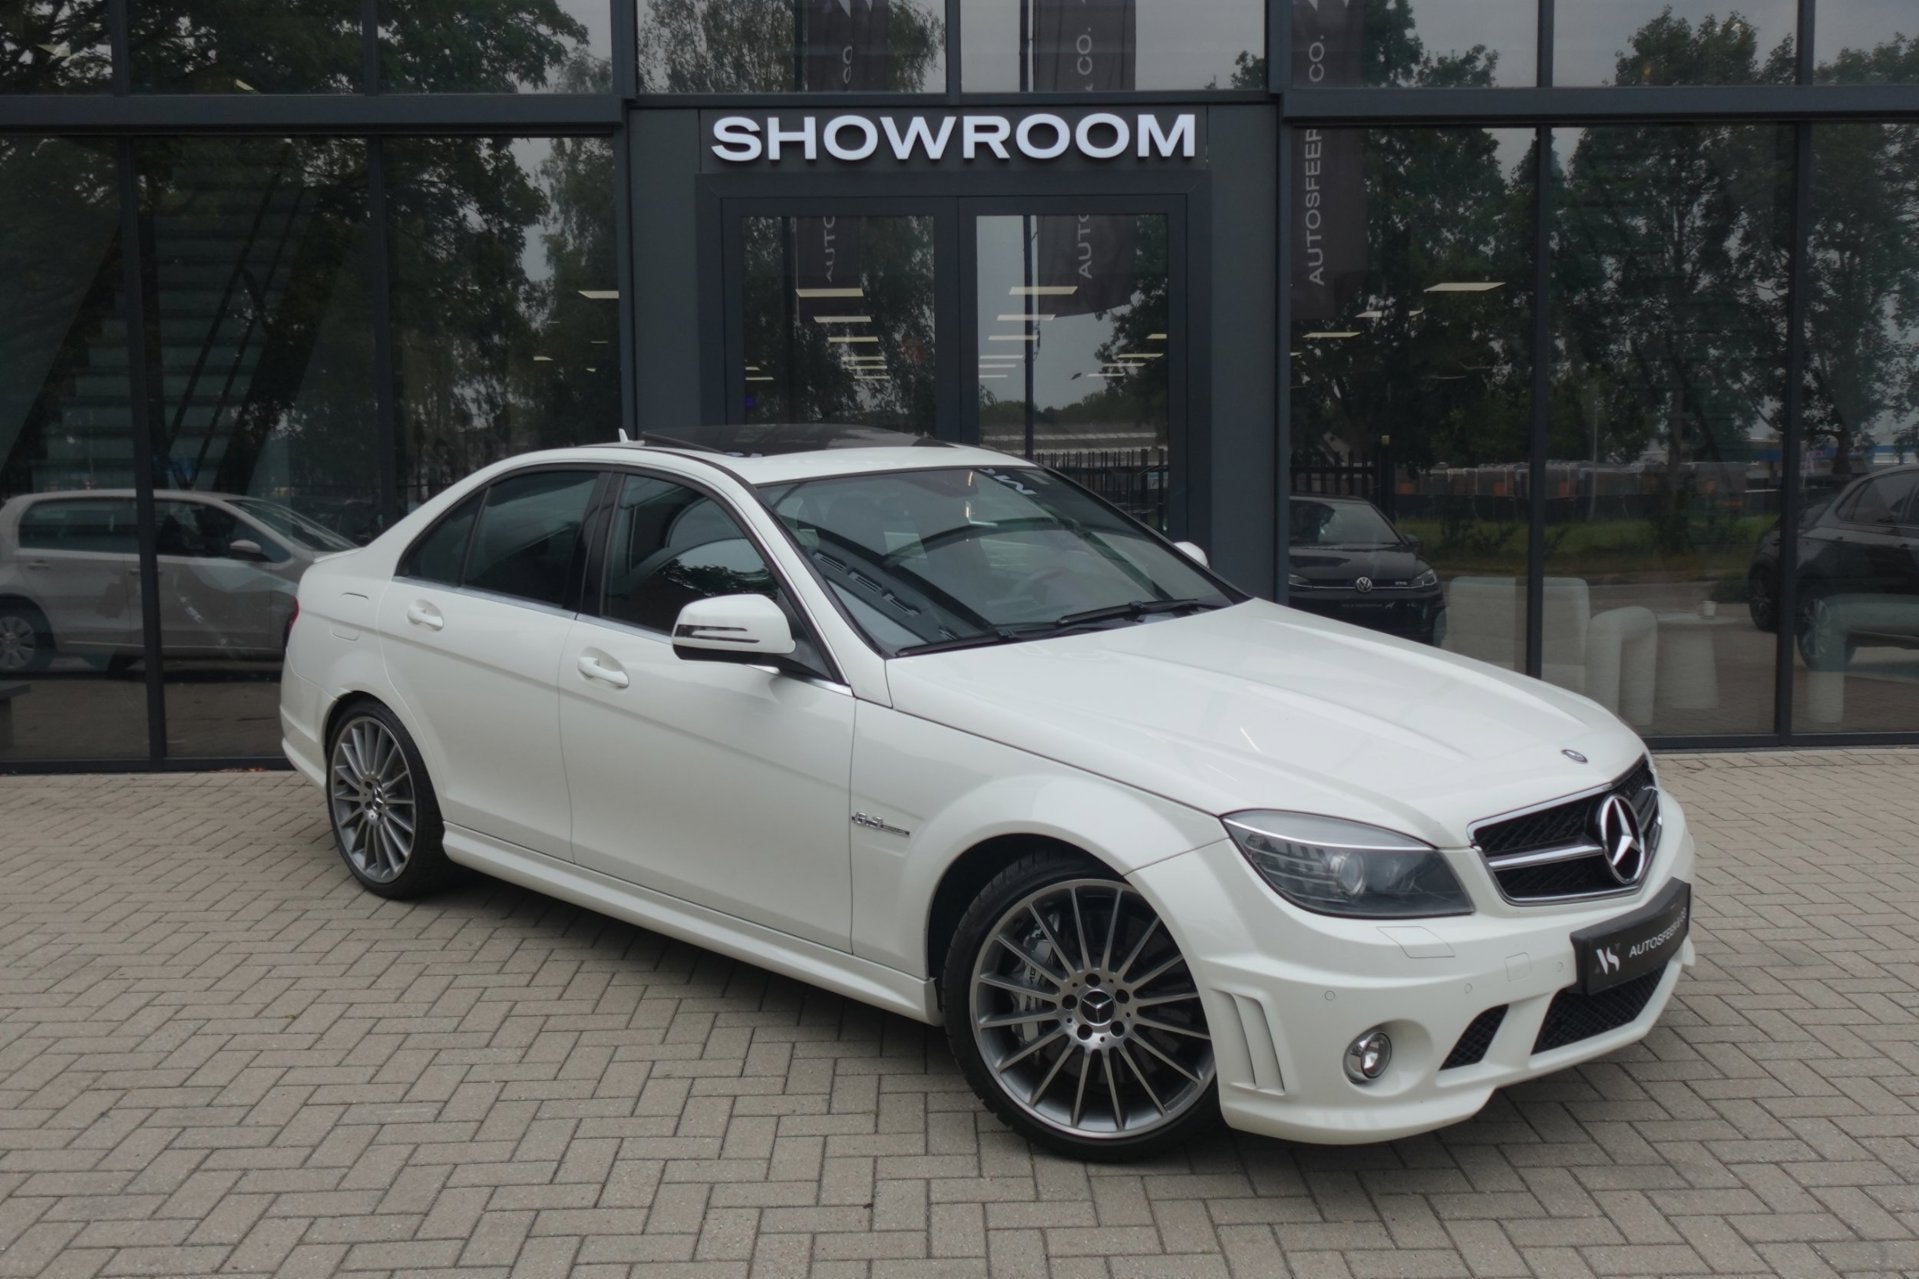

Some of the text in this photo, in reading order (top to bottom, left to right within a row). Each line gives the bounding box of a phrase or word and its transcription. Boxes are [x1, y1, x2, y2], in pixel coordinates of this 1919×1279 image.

[1076, 27, 1093, 76] CO.
[1308, 34, 1325, 82] CO.
[711, 112, 1197, 162] SHOWROOM
